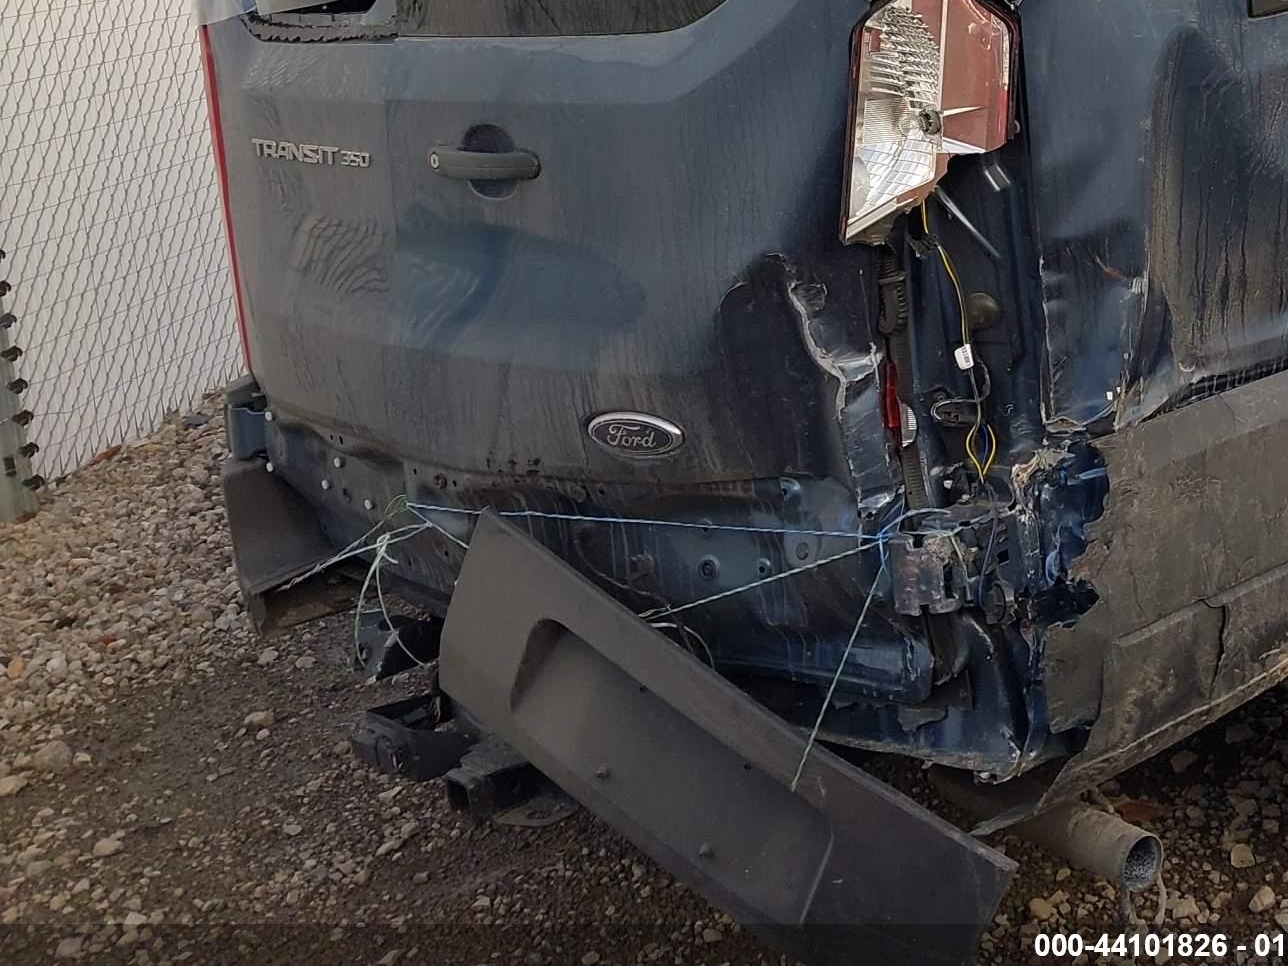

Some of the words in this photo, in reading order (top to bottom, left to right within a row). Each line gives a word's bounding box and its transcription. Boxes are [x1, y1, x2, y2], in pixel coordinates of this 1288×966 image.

[251, 138, 339, 165] TRANSIT
[340, 149, 370, 167] 350
[607, 424, 656, 447] Ford
